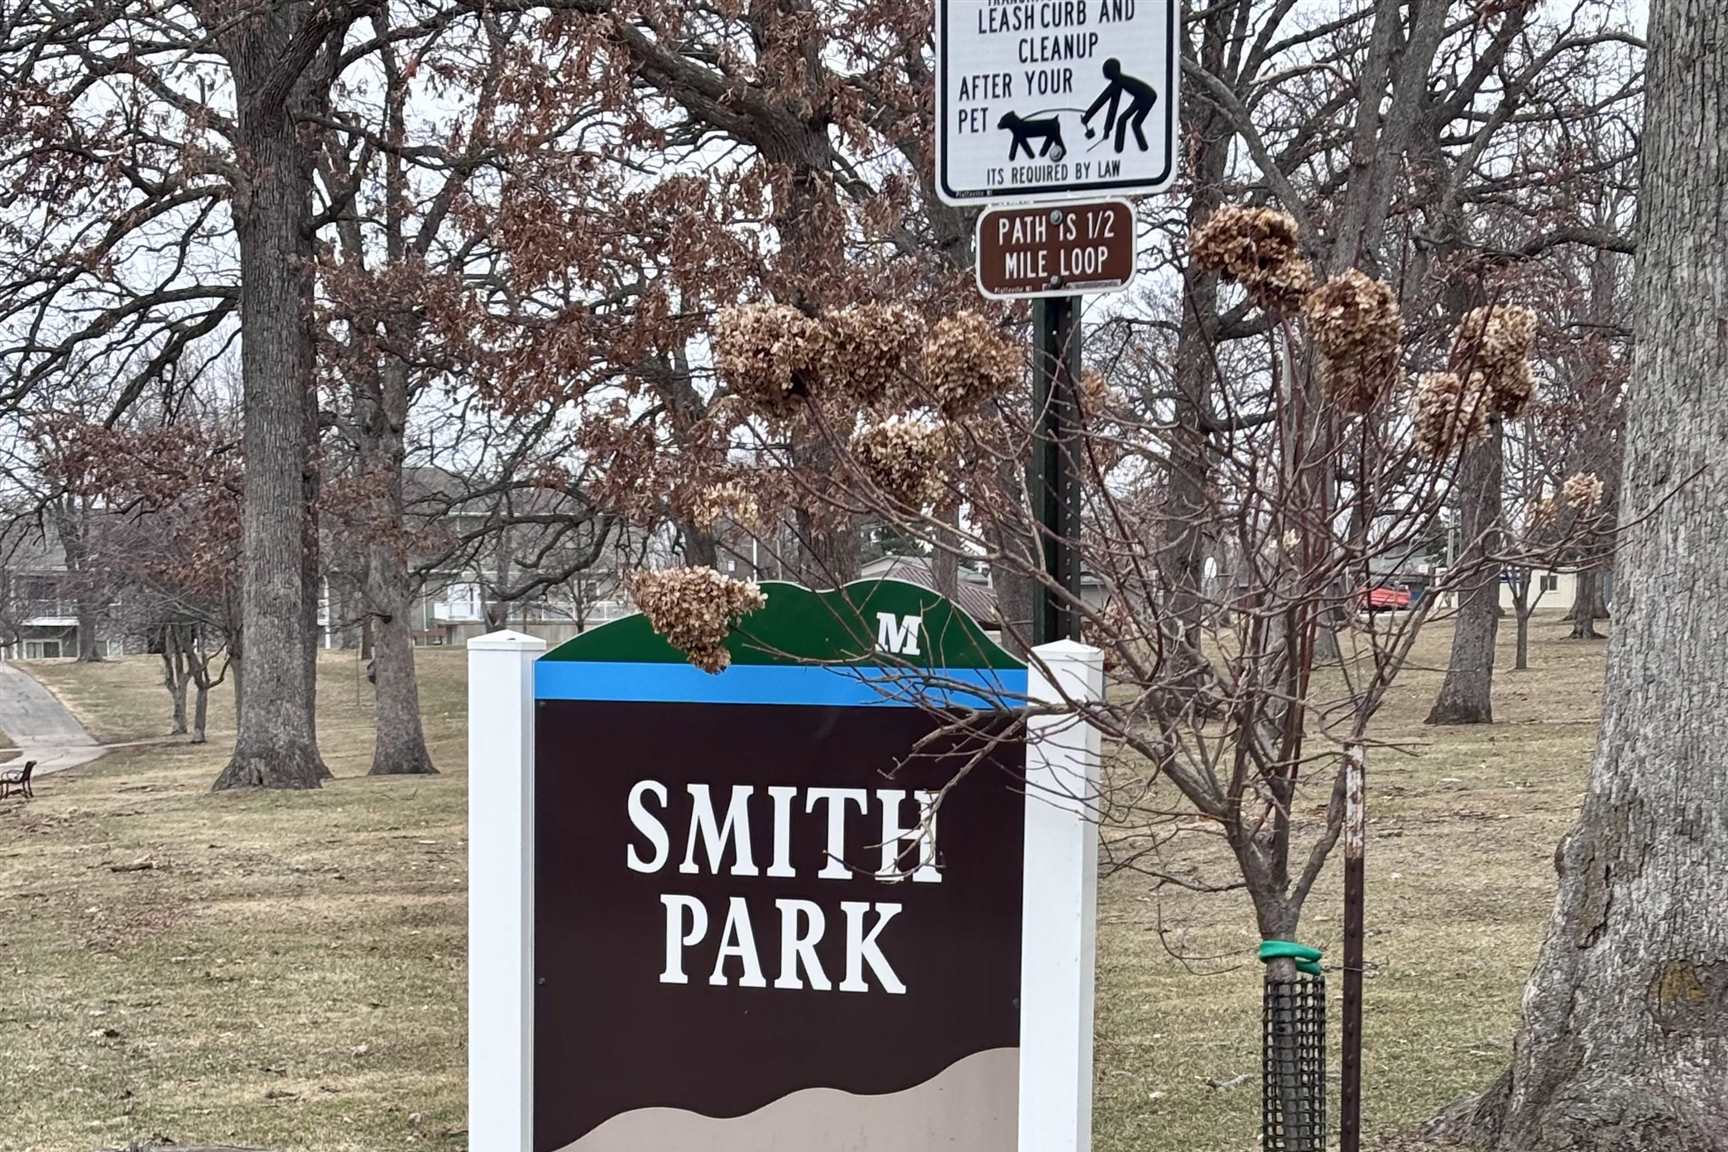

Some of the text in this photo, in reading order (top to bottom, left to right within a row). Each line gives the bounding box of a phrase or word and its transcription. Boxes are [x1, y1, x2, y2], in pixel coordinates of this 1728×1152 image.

[979, 0, 1135, 34] LEASH CURB AND
[1018, 32, 1099, 63] CLEANUP
[959, 68, 1073, 102] AFTER YOUR
[958, 108, 988, 134] PET
[986, 160, 1121, 186] ITS REQUIRED BY LAW
[999, 210, 1114, 245] PATH IS 1/2
[1005, 246, 1108, 279] MILE LOOP
[875, 611, 921, 656] M
[626, 779, 943, 883] SMITH
[659, 893, 906, 994] PARK
